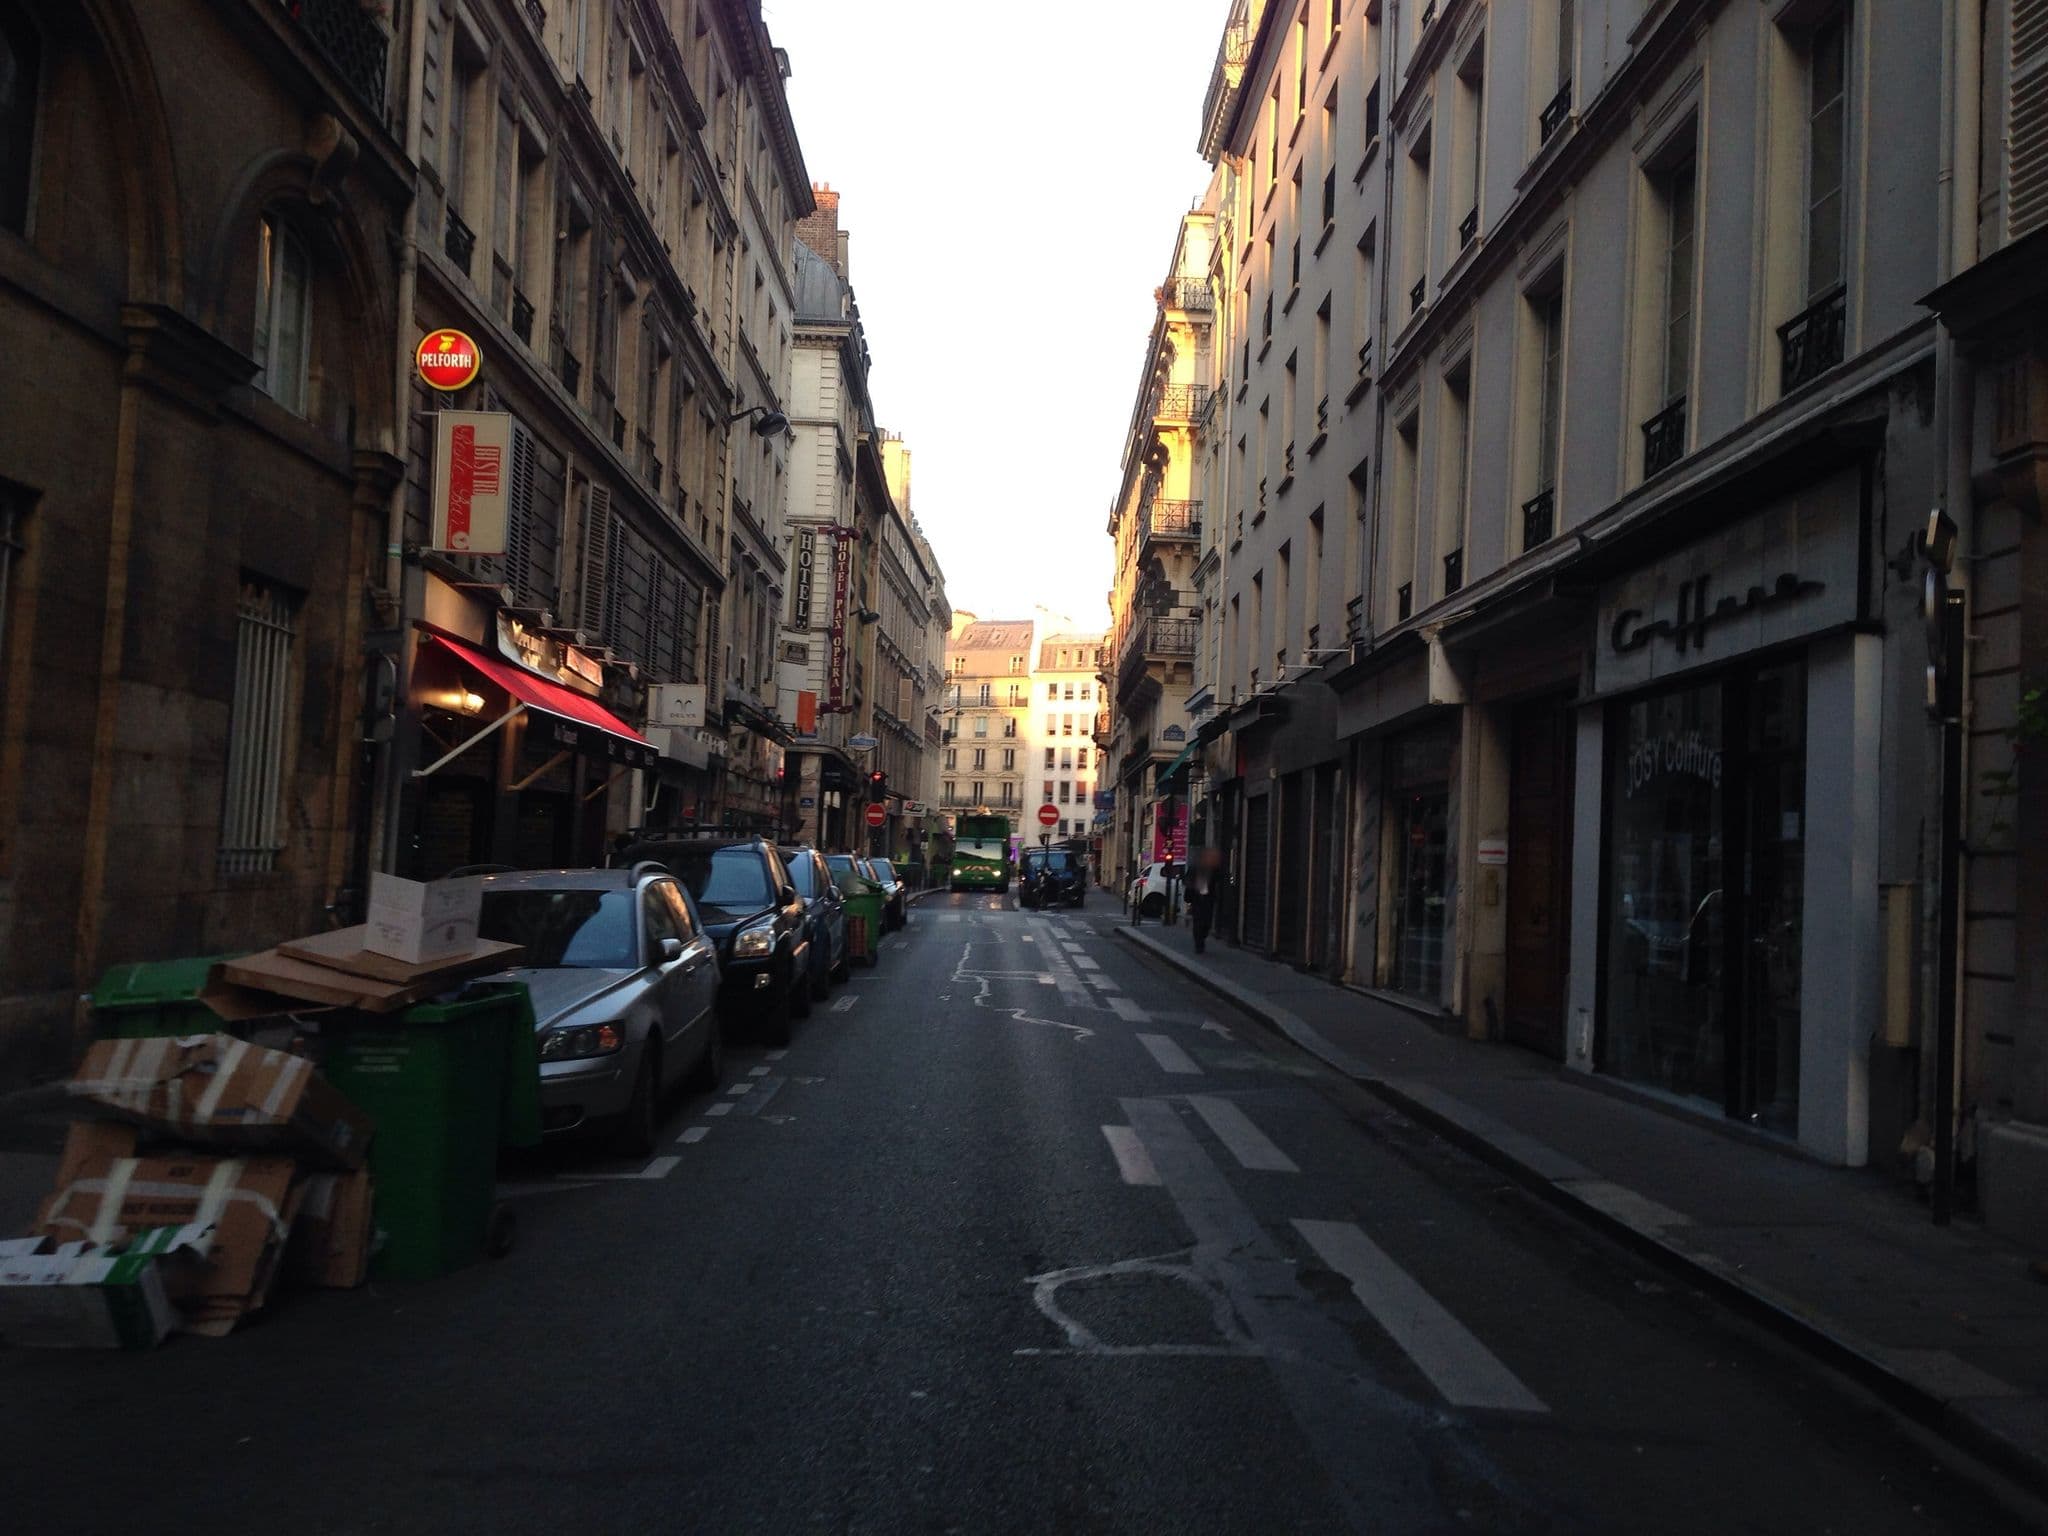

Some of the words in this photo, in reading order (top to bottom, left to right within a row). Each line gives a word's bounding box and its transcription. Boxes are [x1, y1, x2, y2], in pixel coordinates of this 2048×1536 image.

[421, 353, 472, 368] PELFORTH
[474, 447, 500, 496] BISTRO
[798, 534, 814, 617] HOTEL
[836, 541, 848, 592] HOTEL
[831, 637, 843, 688] OPERA
[1665, 730, 1722, 790] Coiffure
